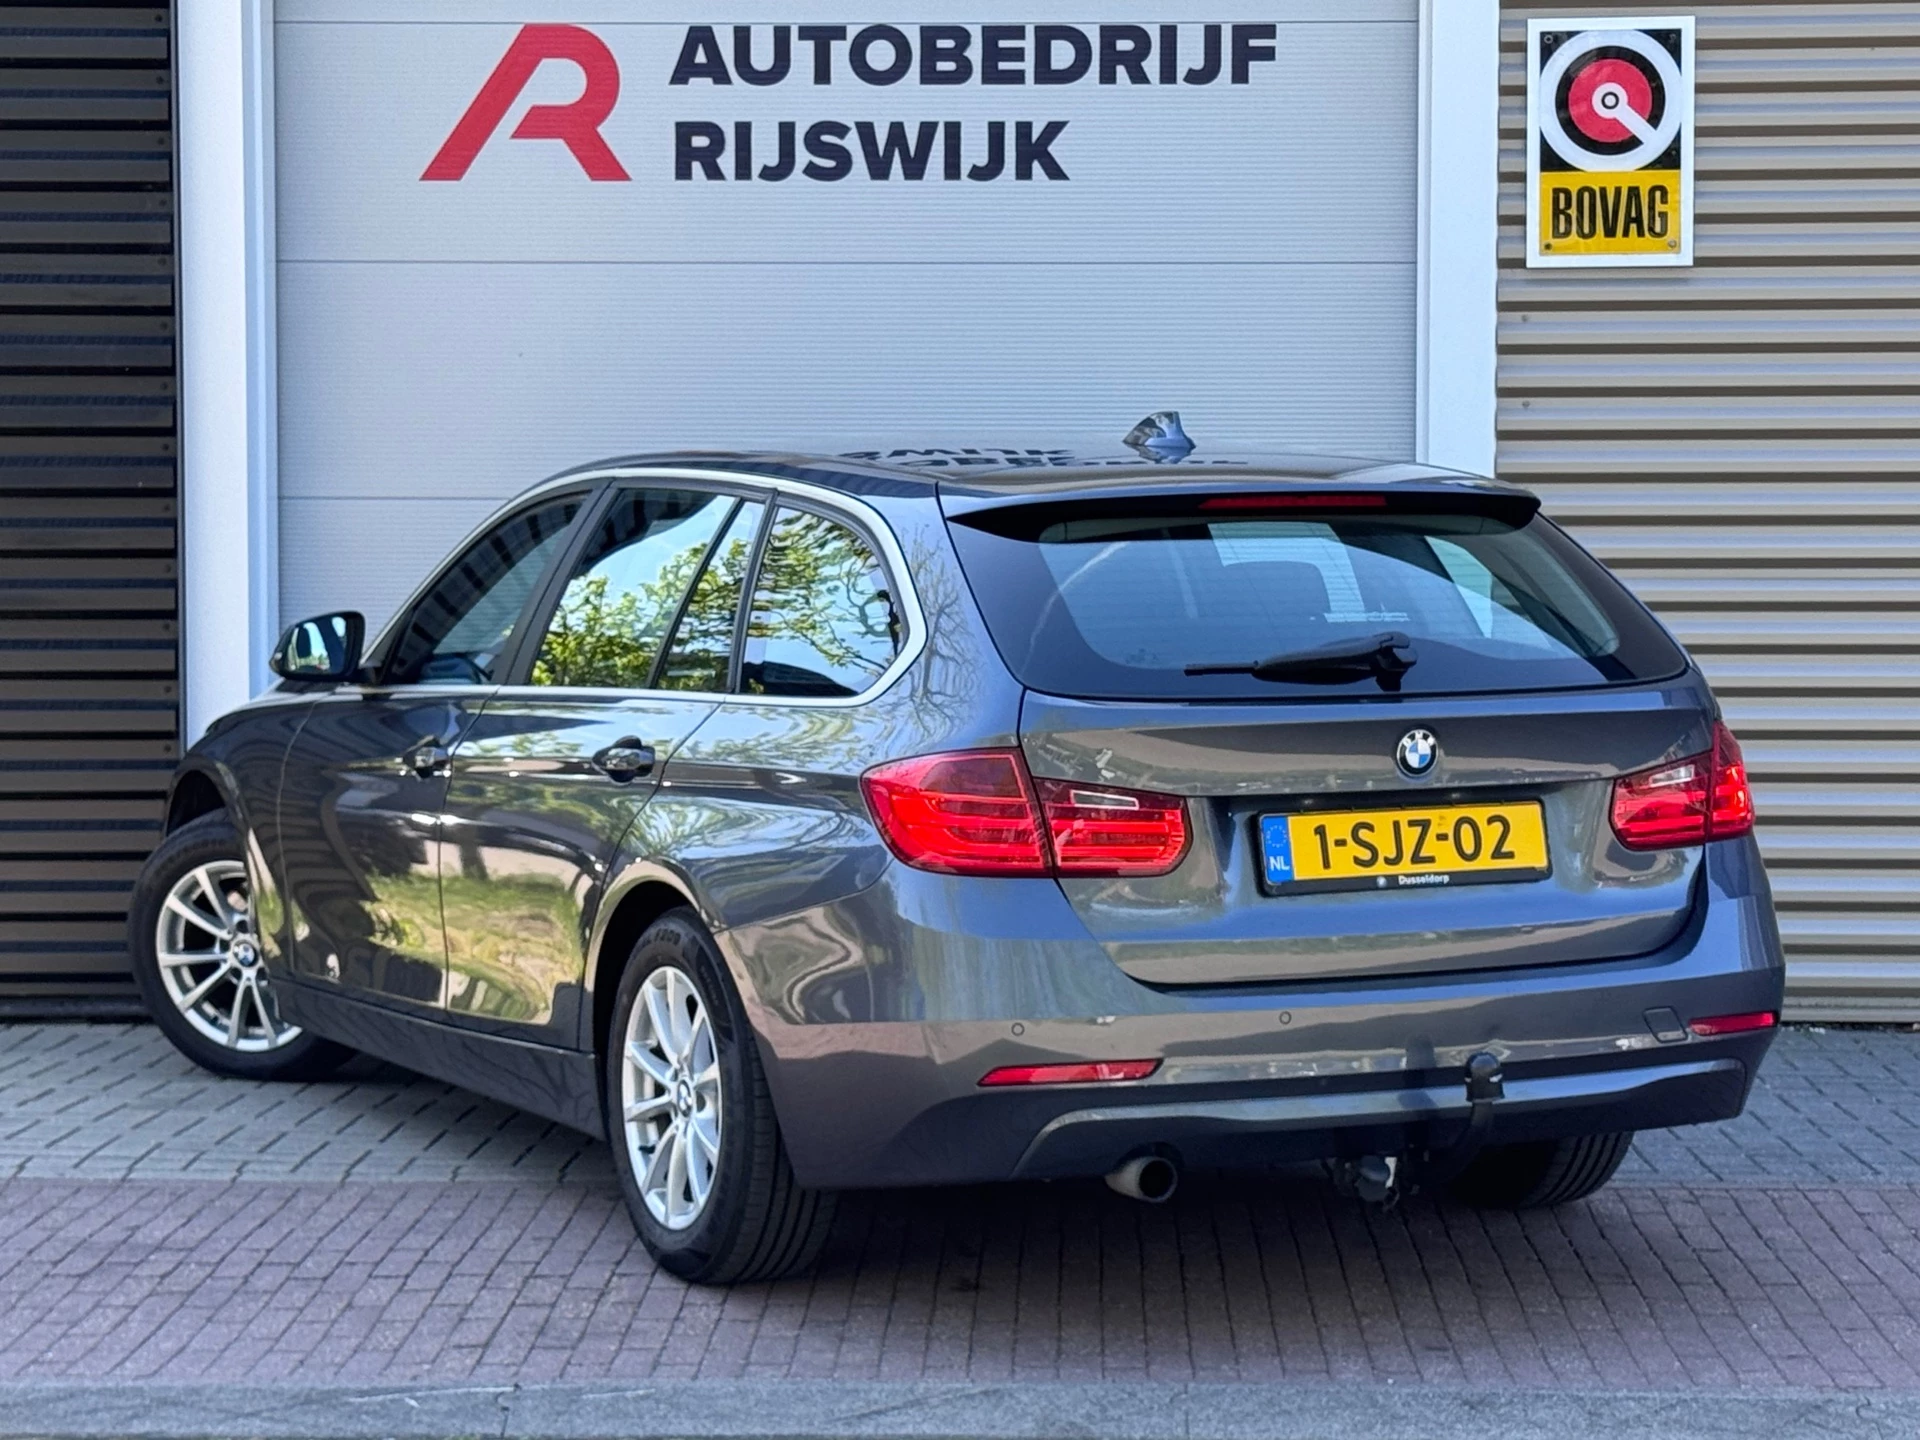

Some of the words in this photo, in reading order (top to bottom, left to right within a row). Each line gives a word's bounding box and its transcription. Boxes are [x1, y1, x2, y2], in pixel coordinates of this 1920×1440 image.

[670, 24, 1277, 86] AUTOBEDRIJF
[675, 121, 1070, 182] RIJSWIJK
[1552, 185, 1669, 240] BOVAG
[1269, 857, 1290, 871] NL
[1314, 815, 1515, 870] 1-SJZ-02
